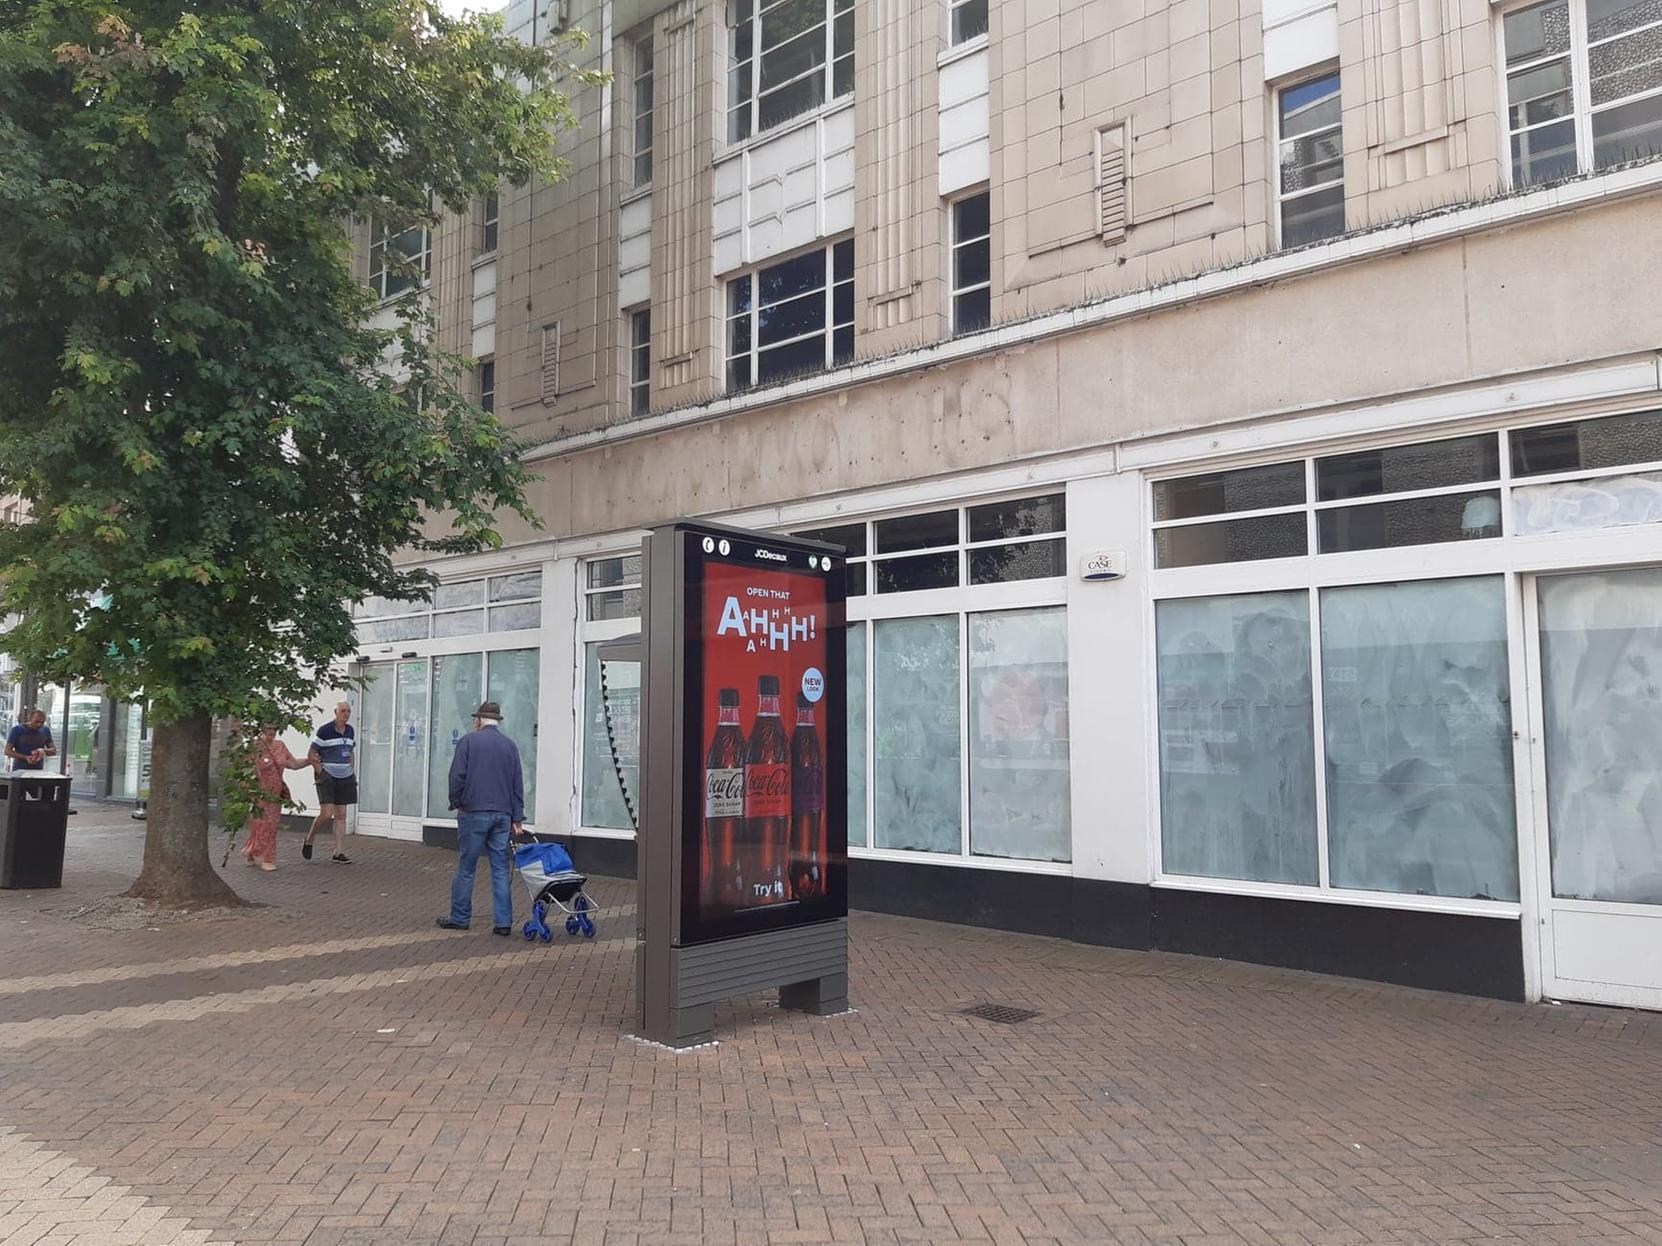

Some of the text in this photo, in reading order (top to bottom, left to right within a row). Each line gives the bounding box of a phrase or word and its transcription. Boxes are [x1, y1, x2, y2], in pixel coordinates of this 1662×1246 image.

[755, 549, 787, 561] JCDecaux
[1088, 561, 1112, 569] CASE
[747, 587, 790, 600] OPEN THAT
[805, 677, 821, 686] NEW
[753, 883, 772, 897] Try
